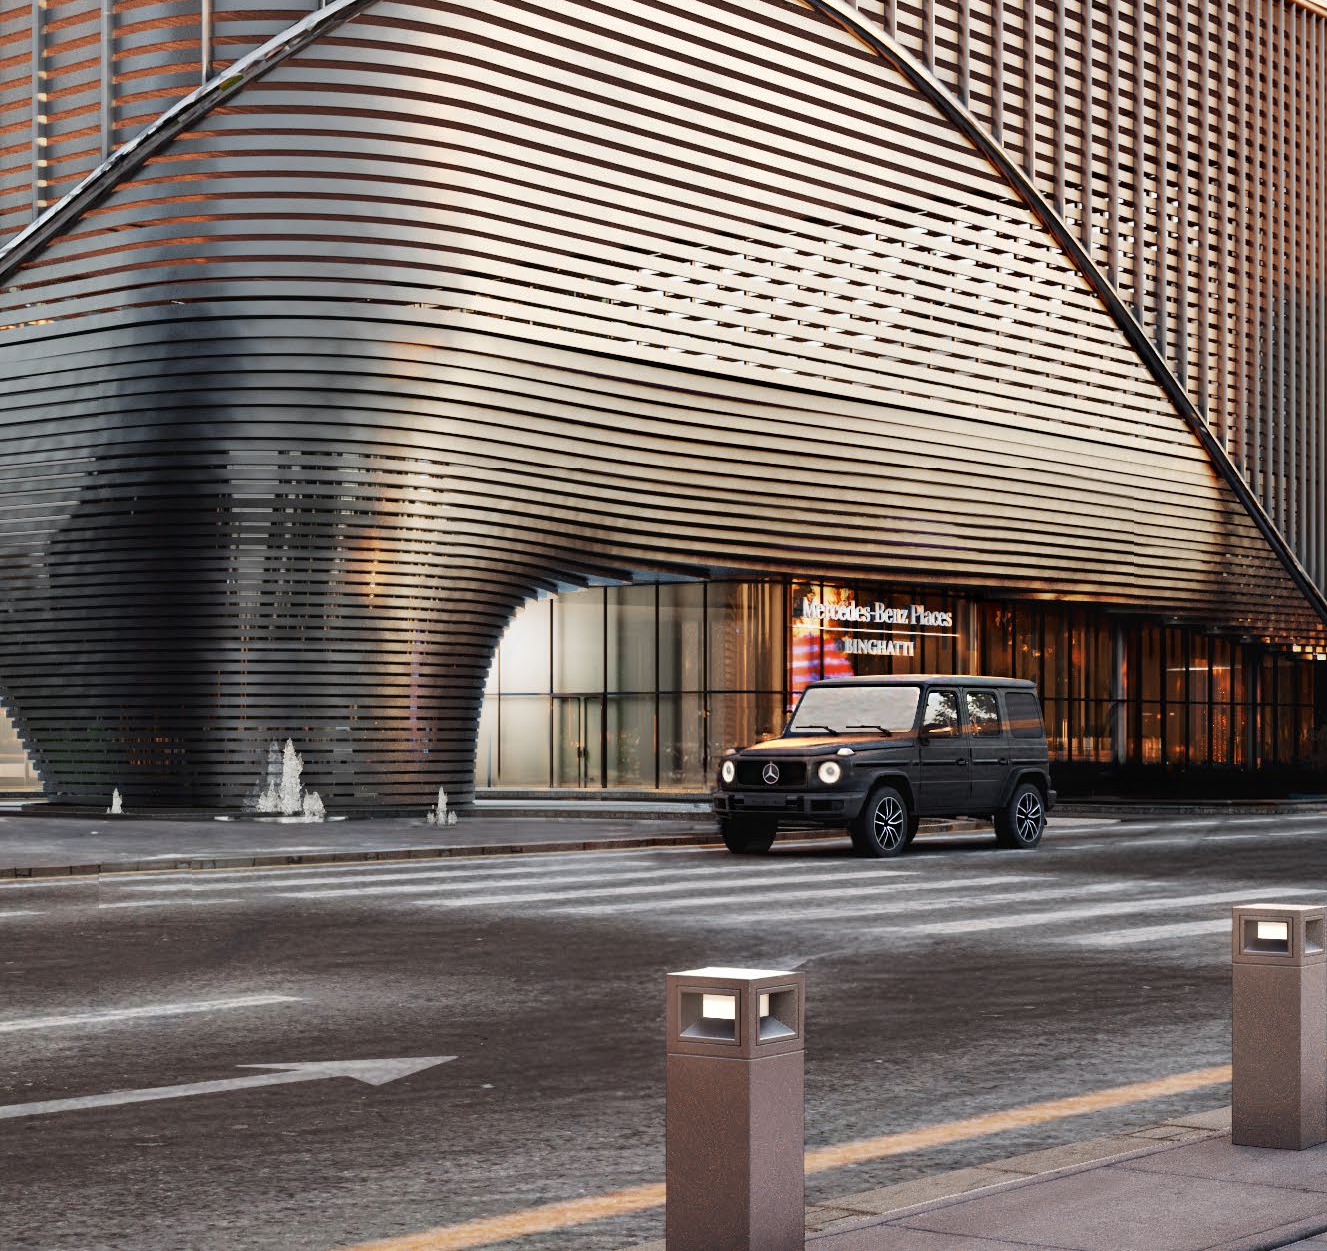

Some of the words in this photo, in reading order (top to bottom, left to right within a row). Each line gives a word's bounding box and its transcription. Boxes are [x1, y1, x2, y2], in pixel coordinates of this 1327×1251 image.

[802, 597, 908, 624] Mercedes-Benz
[910, 604, 952, 627] Places
[844, 638, 914, 656] BINGHATTI
